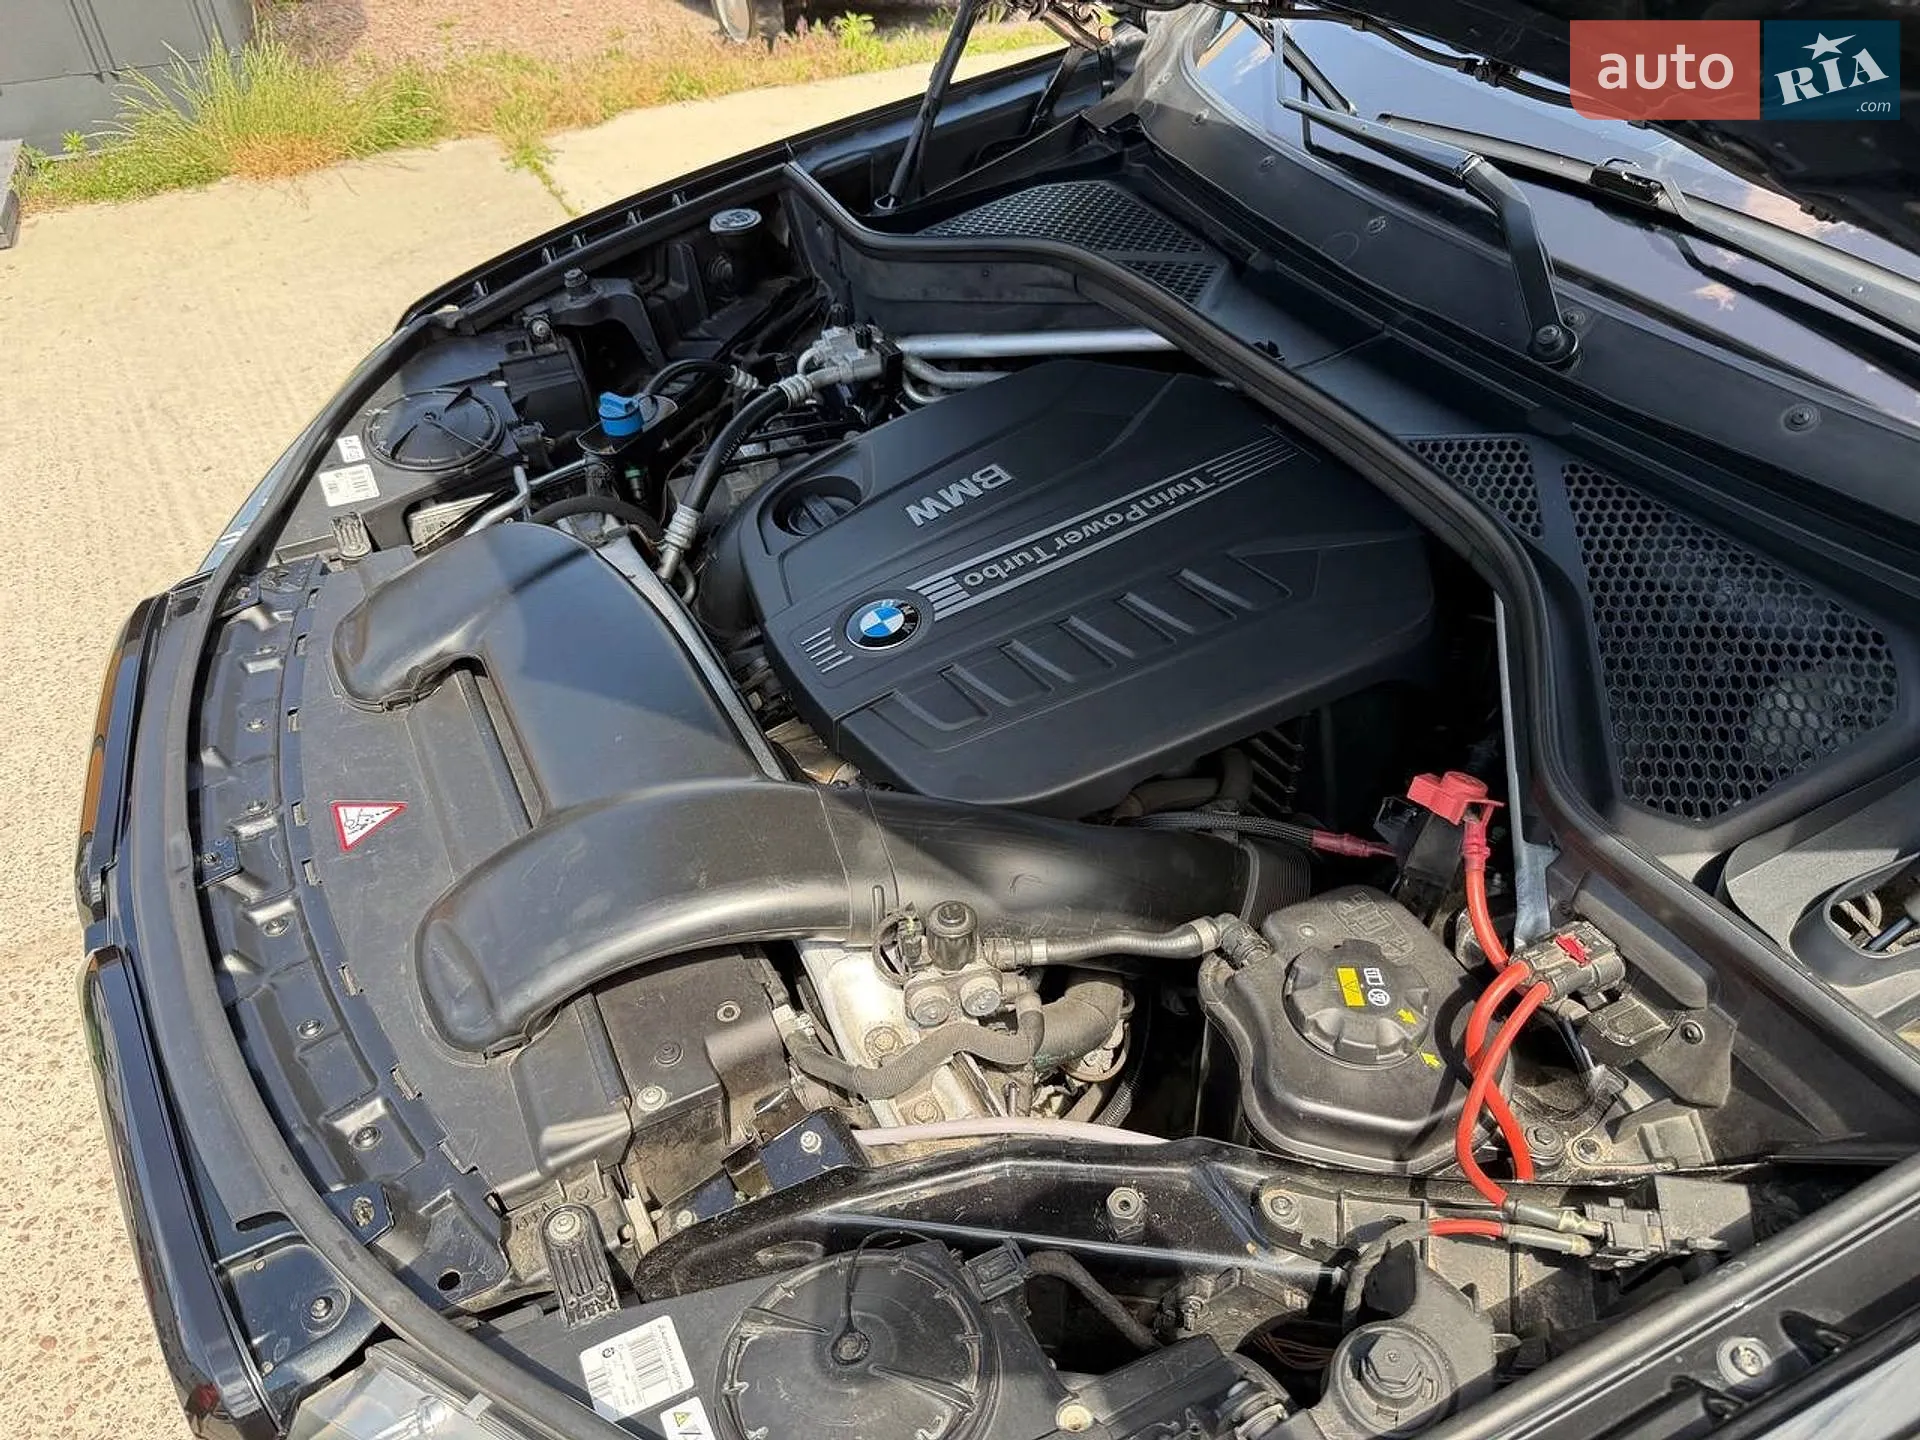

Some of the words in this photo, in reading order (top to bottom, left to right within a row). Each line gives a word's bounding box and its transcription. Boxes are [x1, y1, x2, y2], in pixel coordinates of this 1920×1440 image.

[905, 463, 1013, 527] BMW
[1054, 476, 1216, 550] TwinPower
[964, 545, 1057, 586] Turbo
